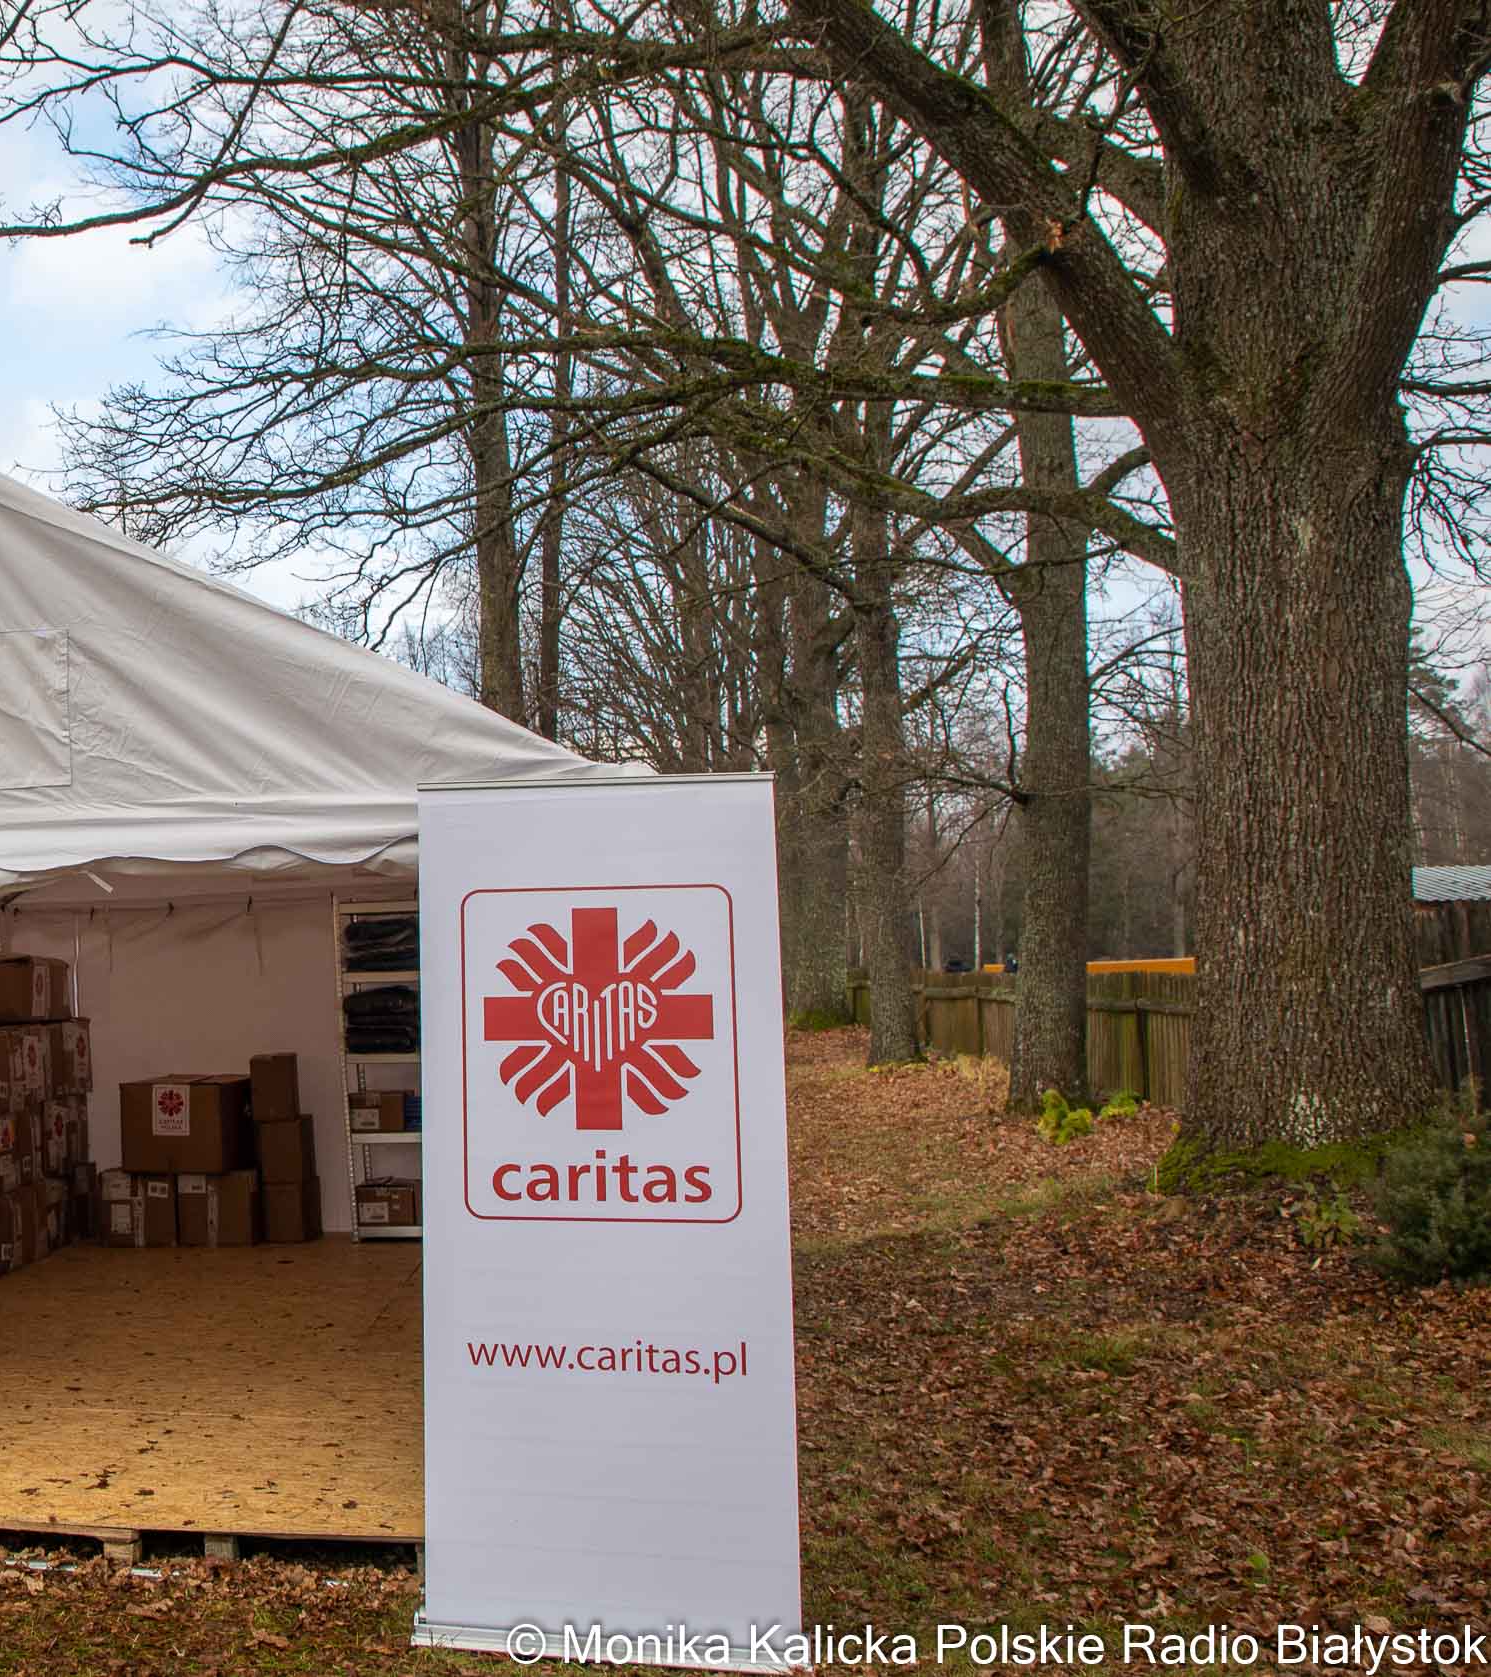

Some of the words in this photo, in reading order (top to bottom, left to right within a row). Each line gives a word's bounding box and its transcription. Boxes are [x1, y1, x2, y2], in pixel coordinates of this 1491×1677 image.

[537, 980, 658, 1073] CARITAS
[491, 1149, 713, 1205] caritas
[467, 1339, 748, 1385] www.caritas.pl
